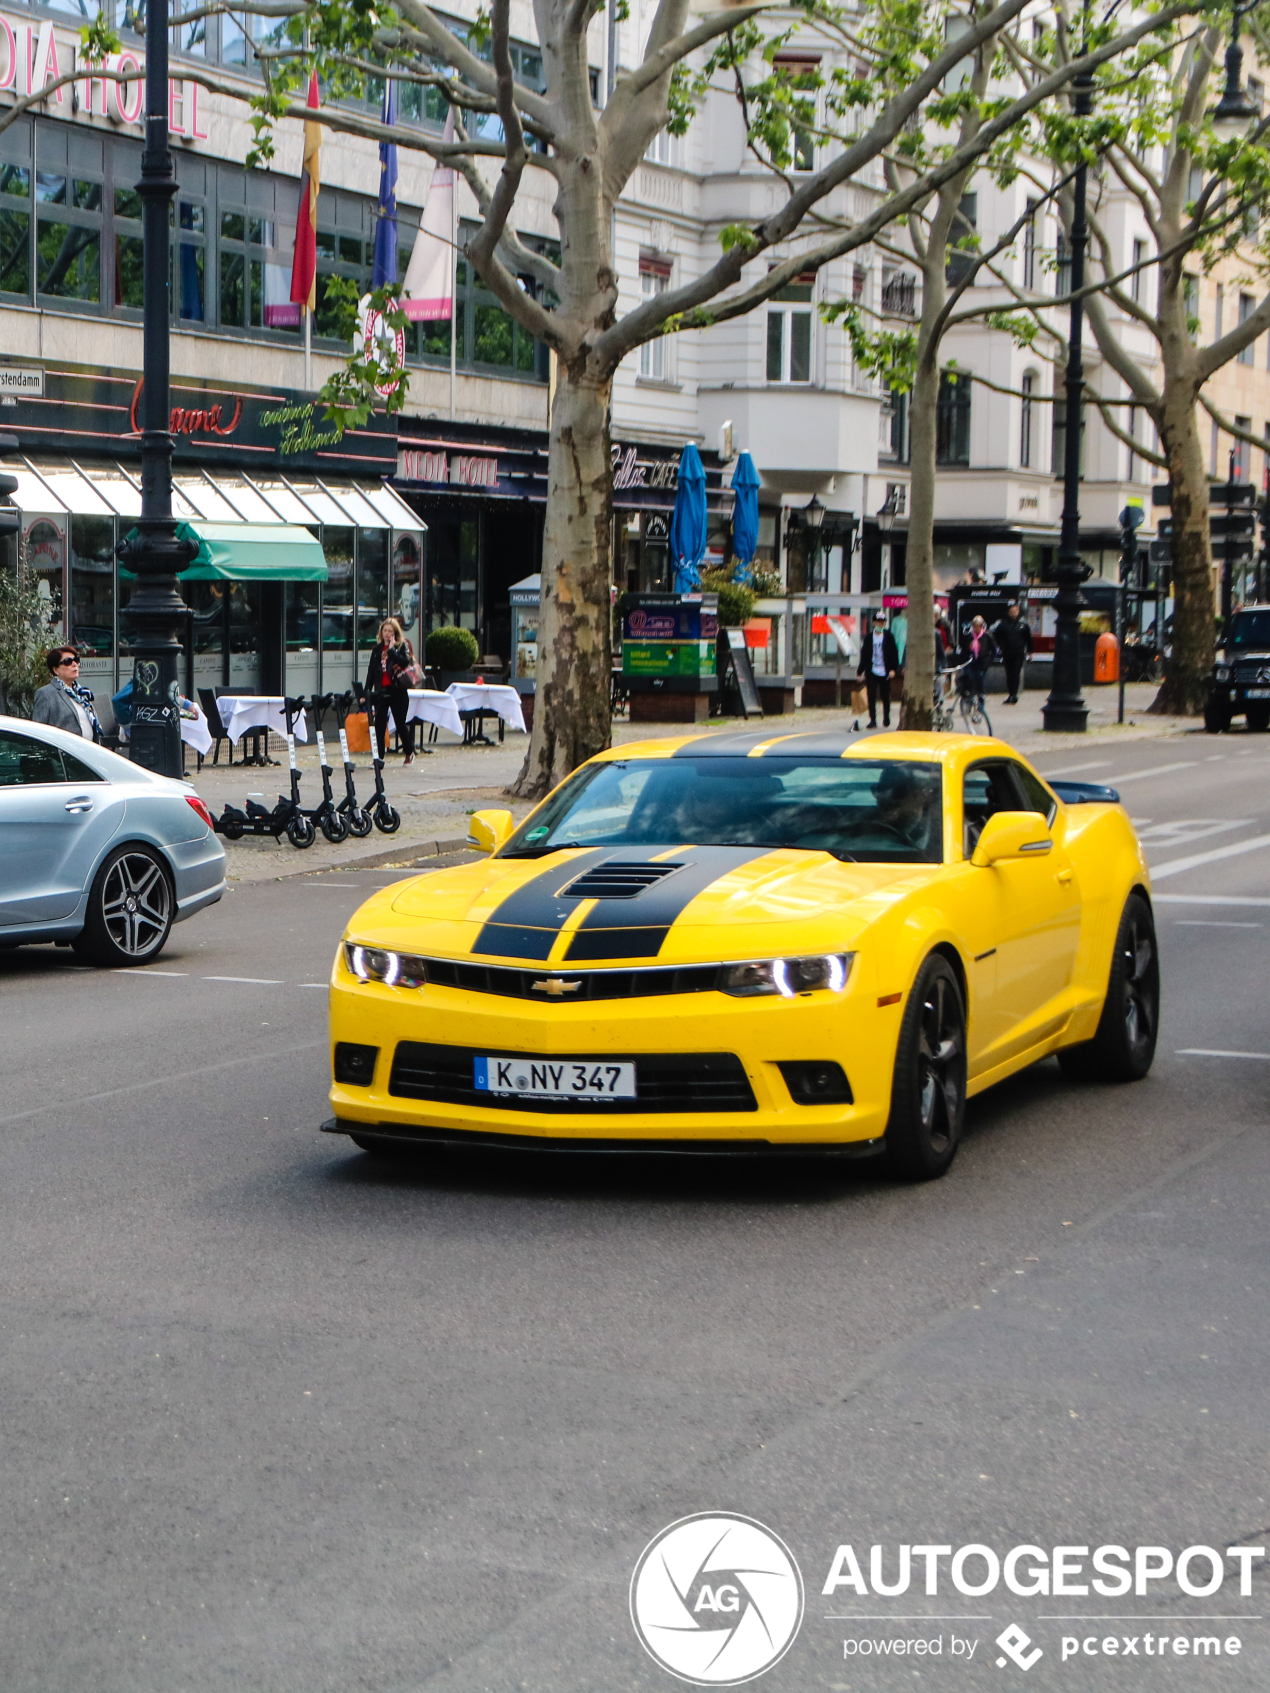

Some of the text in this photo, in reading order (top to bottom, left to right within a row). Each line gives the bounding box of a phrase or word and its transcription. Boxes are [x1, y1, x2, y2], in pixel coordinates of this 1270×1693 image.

[80, 50, 208, 140] HOEL
[402, 450, 500, 487] MEDIA HOTEL
[497, 1062, 621, 1092] K NY 347
